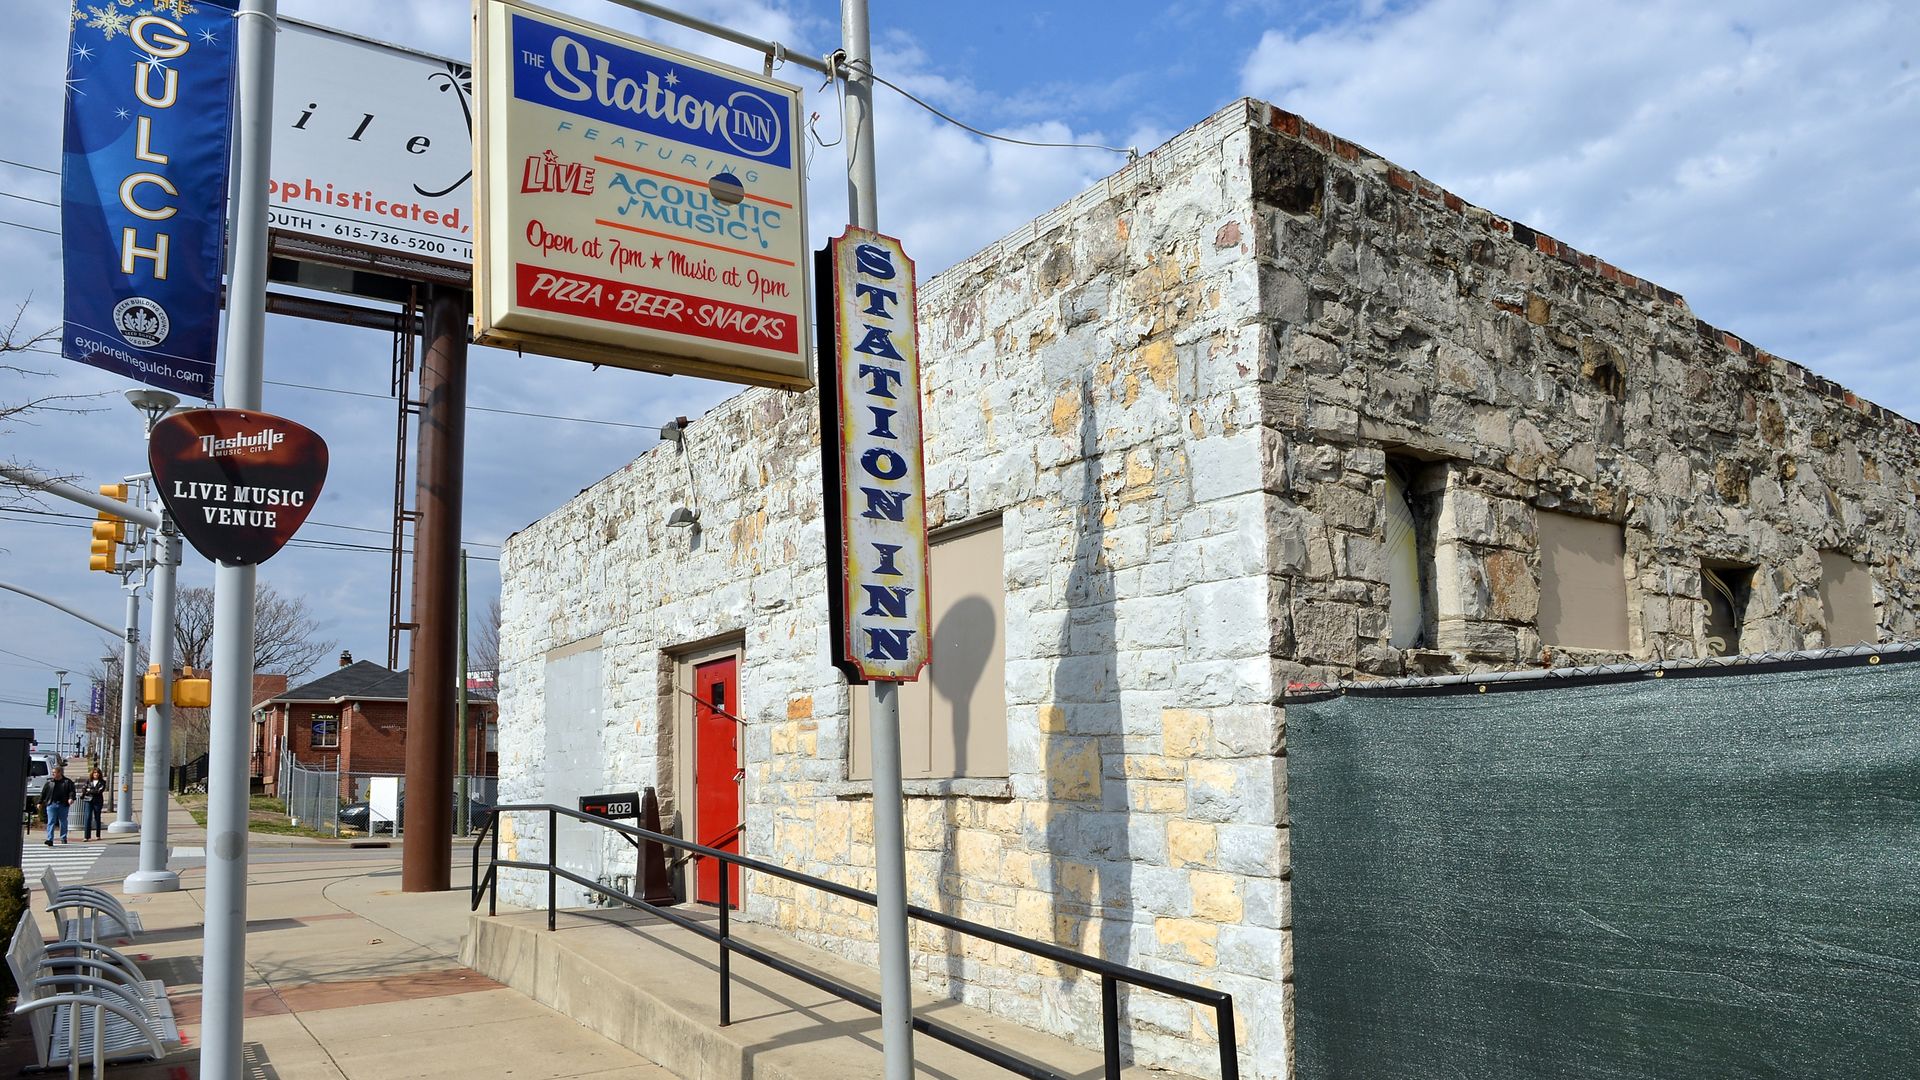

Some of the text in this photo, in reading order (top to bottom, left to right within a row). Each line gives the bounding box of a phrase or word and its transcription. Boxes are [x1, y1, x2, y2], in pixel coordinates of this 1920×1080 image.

[521, 36, 772, 144] THE Station INN
[119, 15, 191, 281] GULCH
[557, 121, 759, 183] FEATURING
[269, 178, 469, 233] ophisticated,
[608, 172, 781, 229] ACOUSTIC
[641, 200, 748, 240] MUSIC
[268, 212, 311, 230] OUTH
[334, 224, 445, 253] 615-736-5200
[526, 219, 789, 303] Open at 7pm Music at 9pm
[130, 299, 160, 313] BUILDING
[529, 273, 786, 340] PIZZA BEER SNACKS
[75, 336, 204, 384] explorethegulch.com
[199, 428, 285, 457] Nashville
[215, 445, 267, 457] MUSIC CITY
[853, 243, 916, 661] STATION INN
[174, 481, 304, 507] LIVE MUSIC
[203, 506, 277, 528] VENUE
[609, 804, 630, 813] 402
